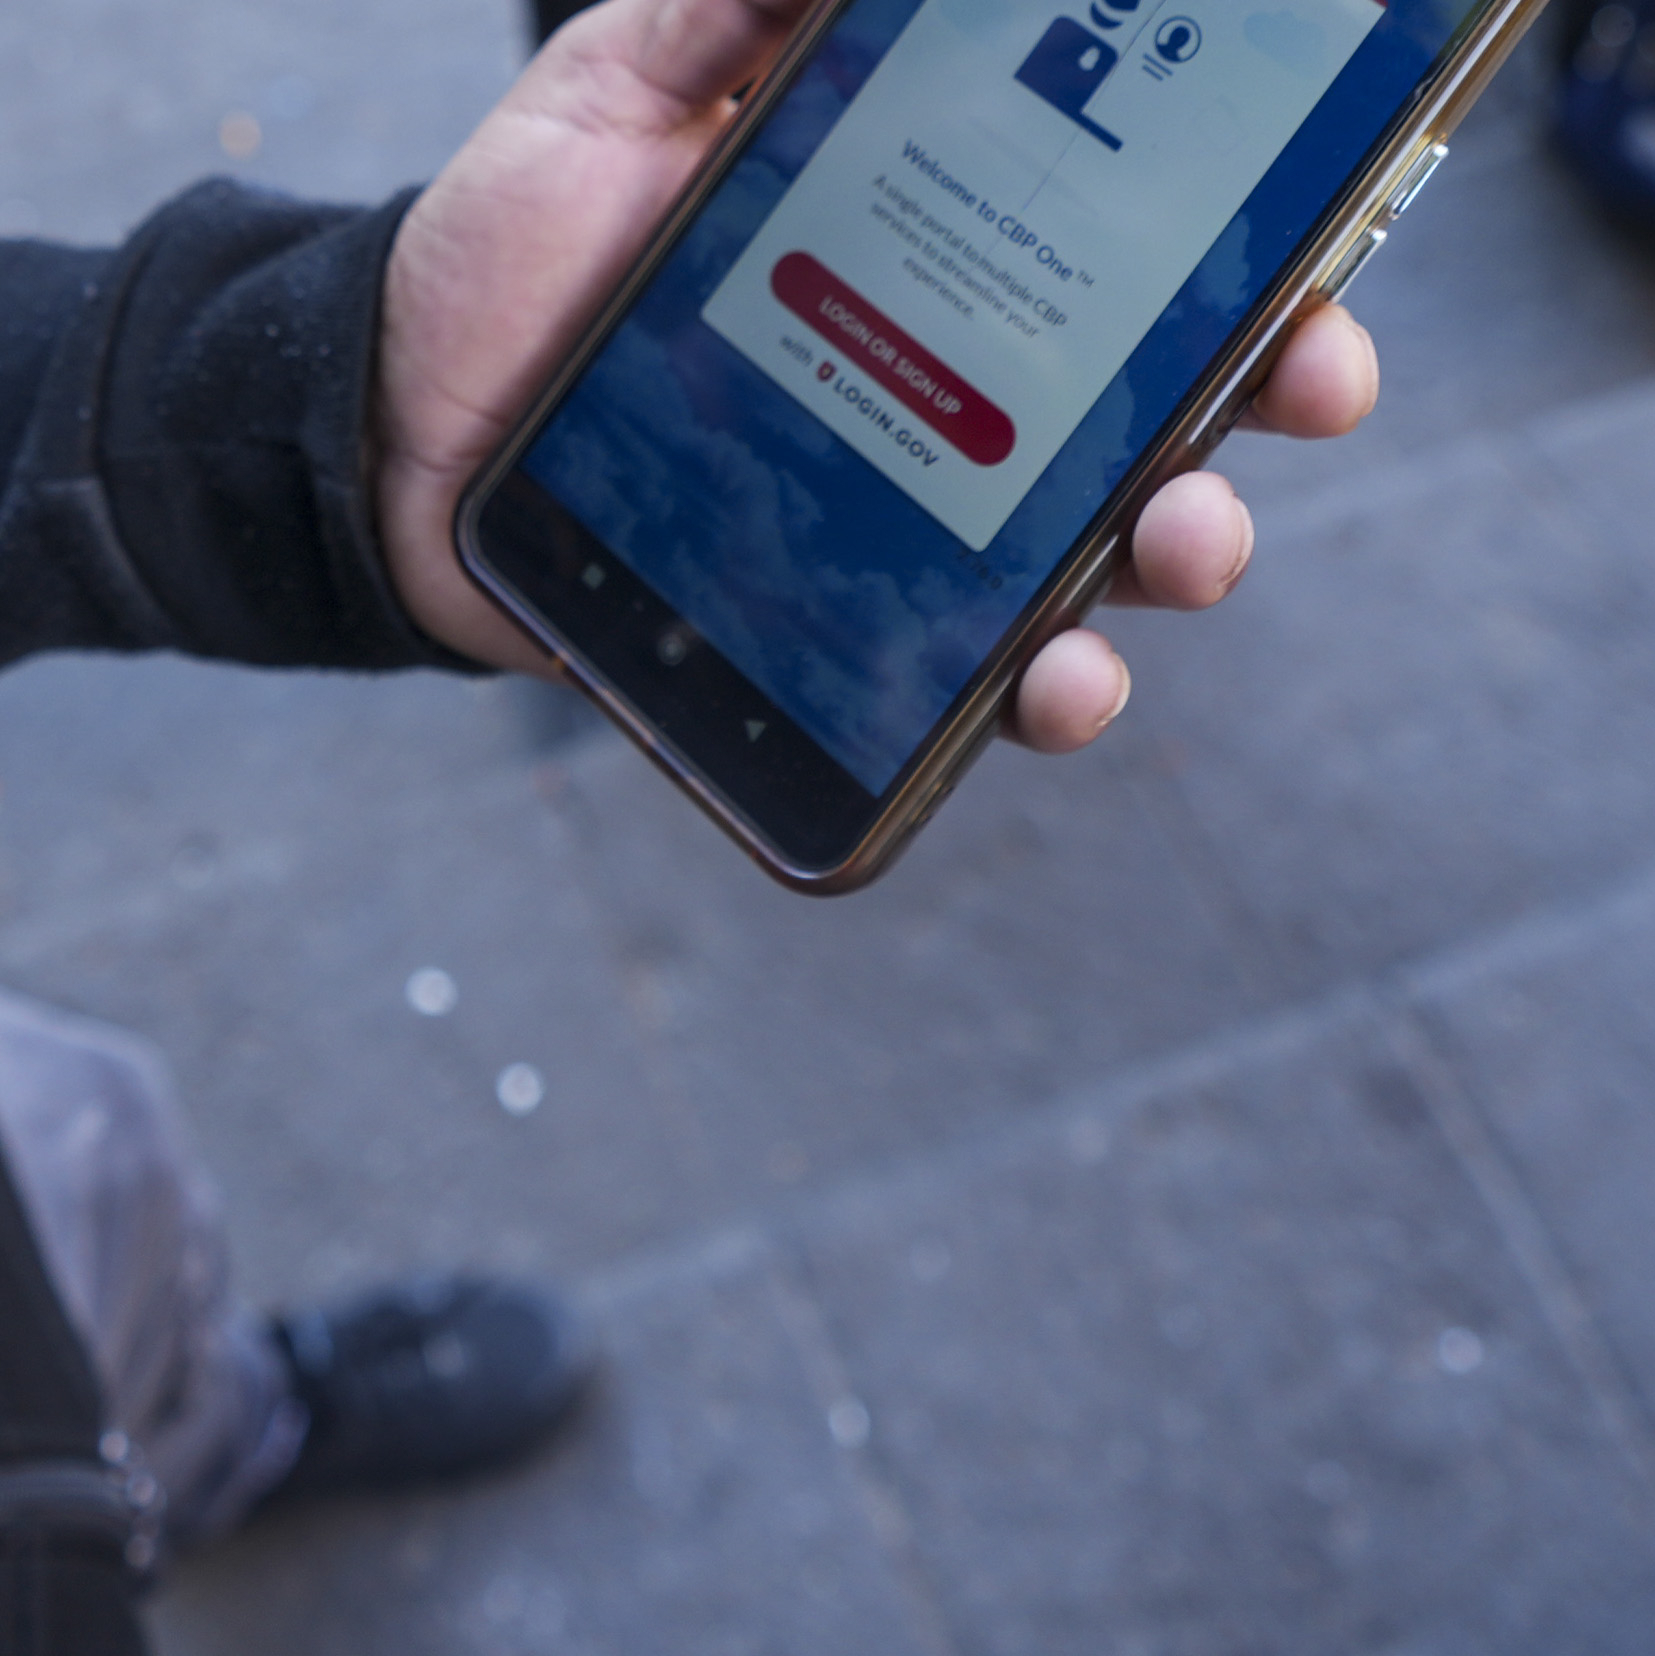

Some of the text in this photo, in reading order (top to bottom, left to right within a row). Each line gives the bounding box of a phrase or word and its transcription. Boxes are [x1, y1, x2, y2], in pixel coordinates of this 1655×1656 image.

[871, 202, 1040, 339] services to streamline your
[872, 173, 1068, 327] A single portal to multiple CBP
[902, 139, 978, 209] Welcome
[977, 200, 997, 224] to
[997, 215, 1038, 248] CBP
[1036, 245, 1073, 282] One
[779, 336, 940, 468] with LOGIN.GOV
[818, 296, 963, 415] LOGIN OR SIGN UP
